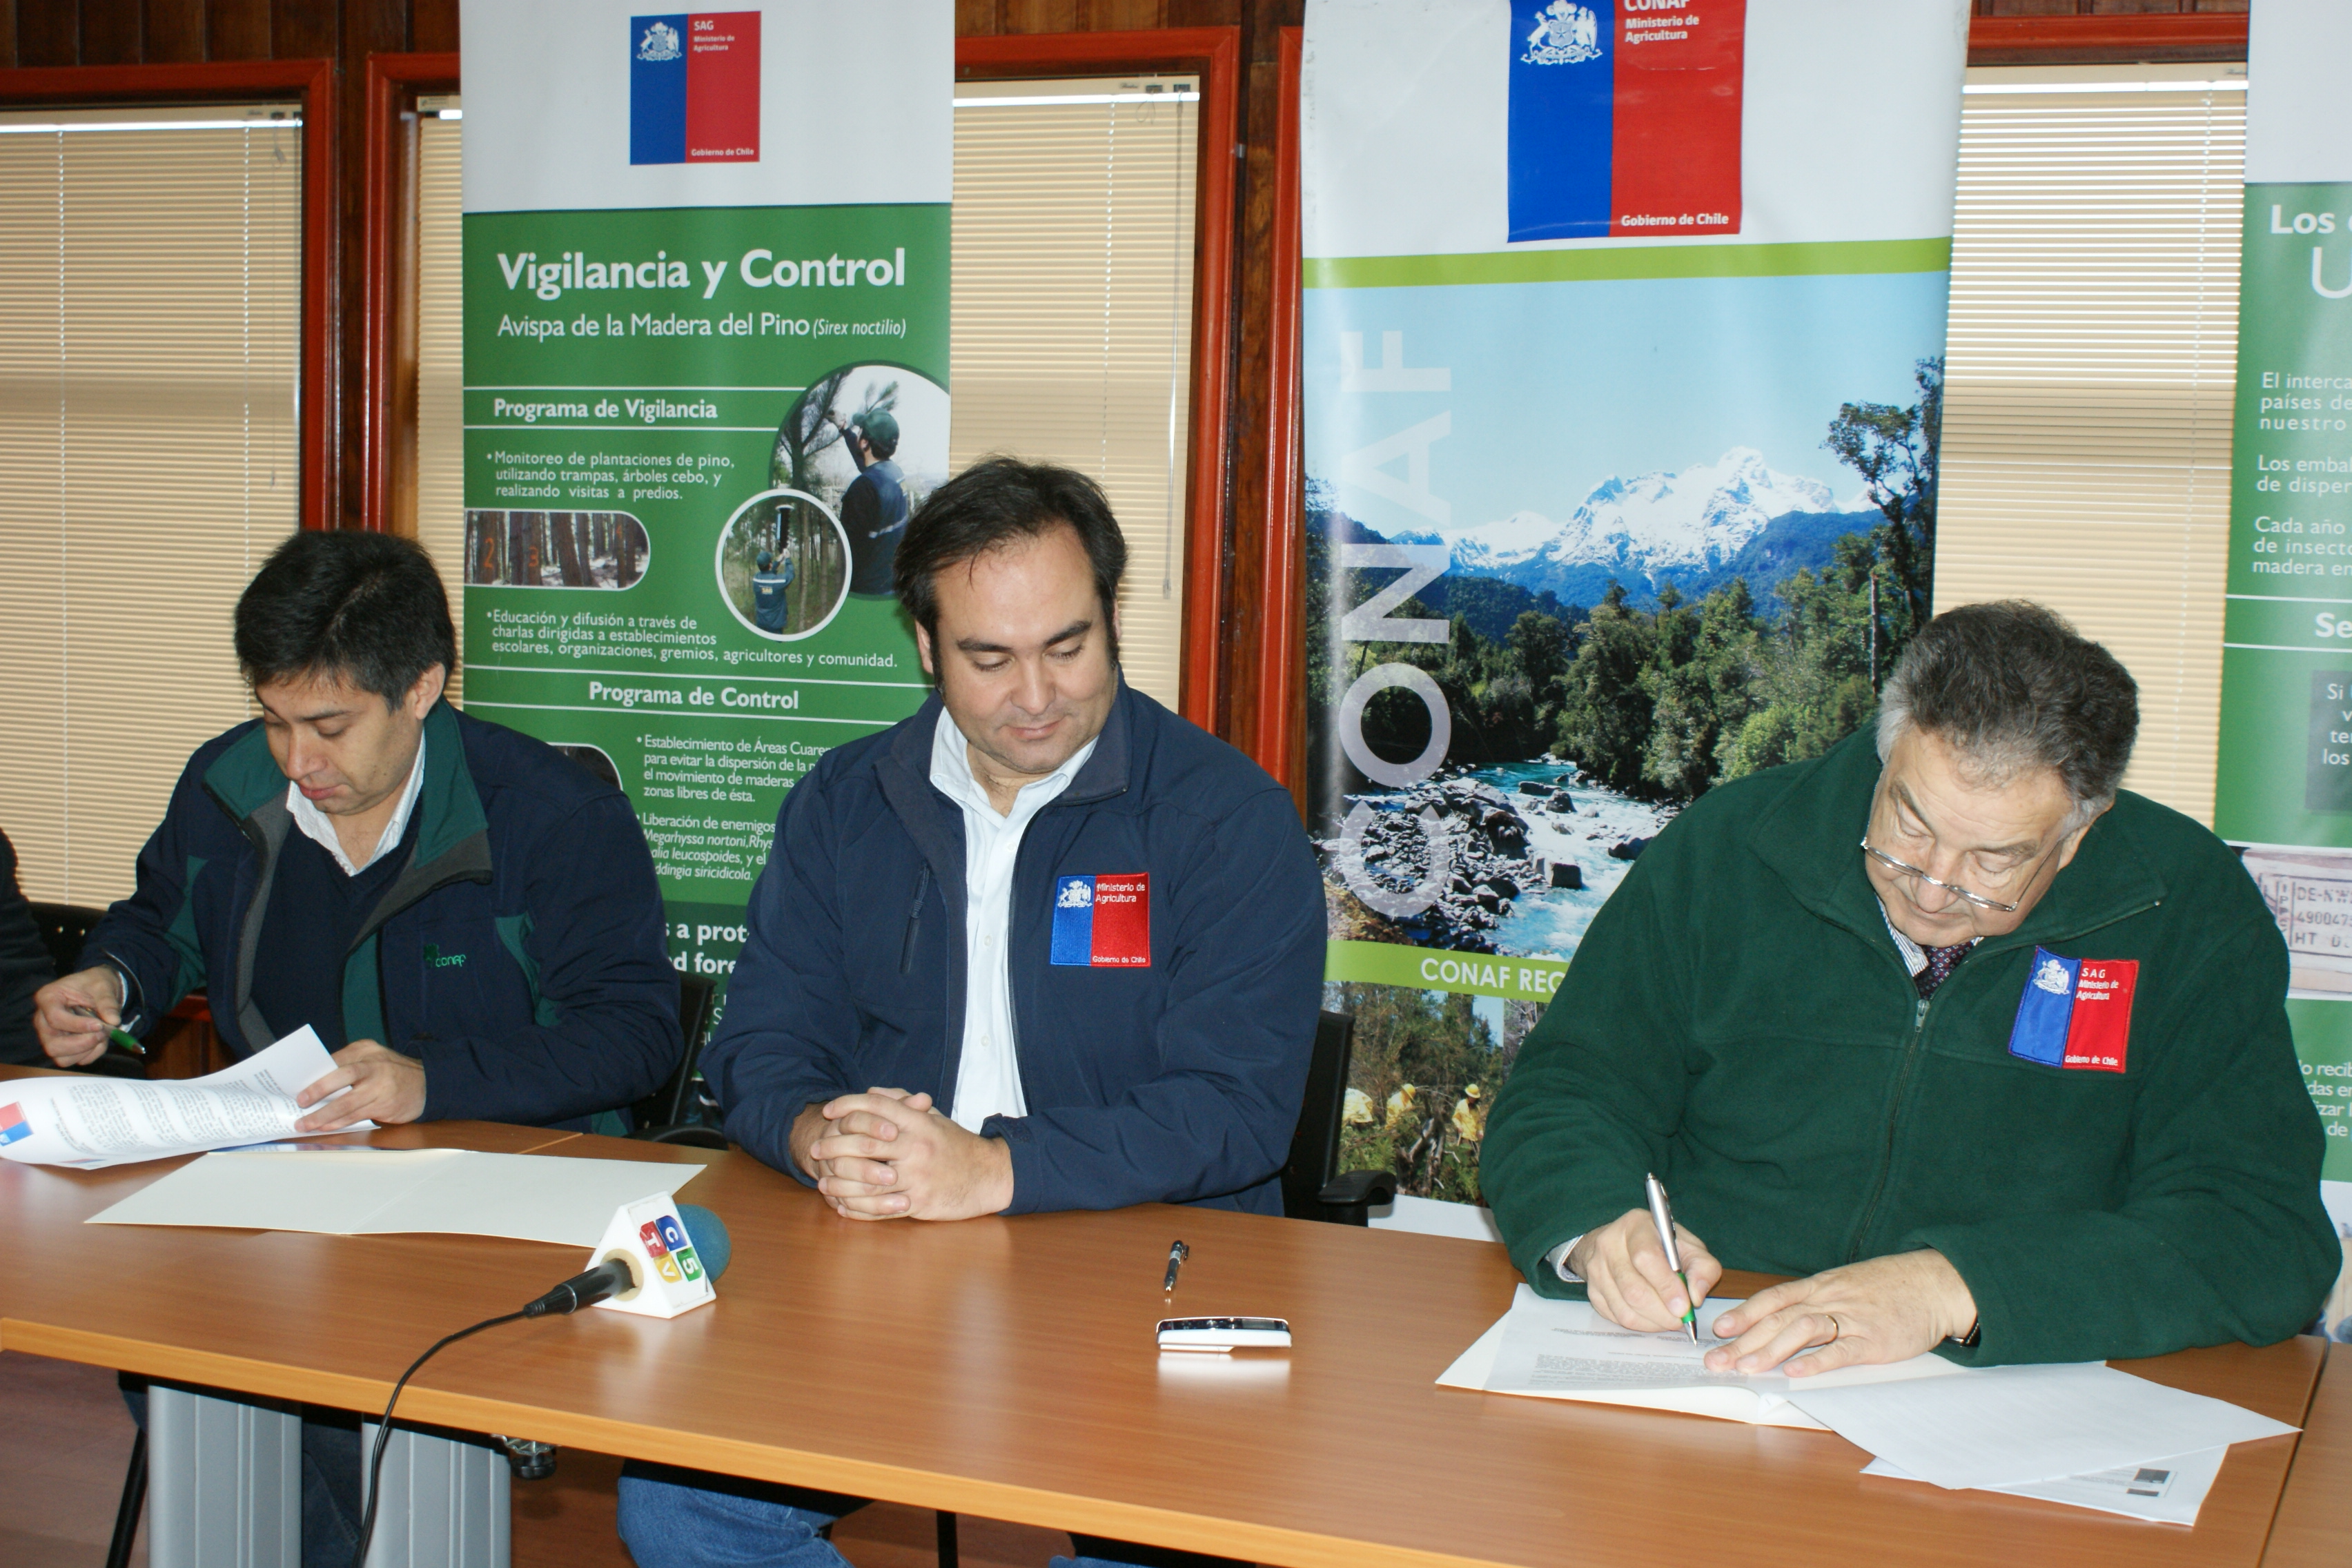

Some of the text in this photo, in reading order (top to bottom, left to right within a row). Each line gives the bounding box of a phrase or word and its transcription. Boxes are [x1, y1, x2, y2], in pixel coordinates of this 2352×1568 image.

[694, 21, 714, 31] SAG
[1625, 15, 1699, 29] Ministerio de
[1625, 30, 1687, 44] Agricultura
[694, 43, 729, 52] Agricultura
[691, 147, 754, 157] Gobierno de Chile
[1621, 213, 1729, 226] Gobierno de Chile
[2271, 205, 2335, 234] Los
[498, 248, 905, 300] Vigilancia y Control
[498, 313, 906, 342] Avispa de la Madera del Pino (Sirex noctilio)
[2261, 372, 2280, 389] El
[493, 398, 718, 423] Programa de Vigilancia
[2260, 393, 2322, 413] países
[2259, 418, 2346, 431] nuestro
[495, 451, 734, 470] Monitoreo de plantaciones de pino,
[2257, 455, 2290, 471] Los
[496, 469, 722, 487] utilizando trampas, árboles cebo, y
[2256, 476, 2281, 491] de
[496, 484, 683, 502] realizando visitas a predios.
[2253, 516, 2346, 534] Cada año
[2253, 537, 2277, 553] de
[2252, 558, 2325, 576] madera
[493, 609, 697, 630] Educación y difusión a través de
[1339, 330, 1452, 918] CONAF
[492, 625, 716, 645] charlas dirigidas a establecimientos
[492, 640, 897, 667] escolares, organizaciones, gremios, agricultores y comunidad.
[589, 681, 798, 709] Programa de Control
[2327, 683, 2344, 700] Si
[645, 734, 834, 756] Establecimiento de Áreas Cuare
[645, 754, 667, 767] para
[670, 754, 703, 767] evitar
[705, 754, 715, 767] la
[718, 756, 776, 771] dispersión
[779, 758, 793, 772] de
[797, 759, 807, 772] la
[2322, 749, 2350, 765] los
[644, 768, 794, 788] el movimiento de maderas
[644, 785, 755, 803] zonas libres de ésta.
[643, 812, 776, 836] Liberación de enemigos
[672, 847, 743, 865] leucospoides,
[747, 854, 754, 868] y
[756, 852, 766, 865] el
[1097, 883, 1145, 892] Ministerio de
[1096, 894, 1137, 903] Agricultura
[676, 923, 690, 939] a
[697, 924, 749, 945] prot
[1092, 955, 1119, 963] Gobierno
[1421, 958, 1510, 989] CONAF
[2326, 1121, 2348, 1136] de
